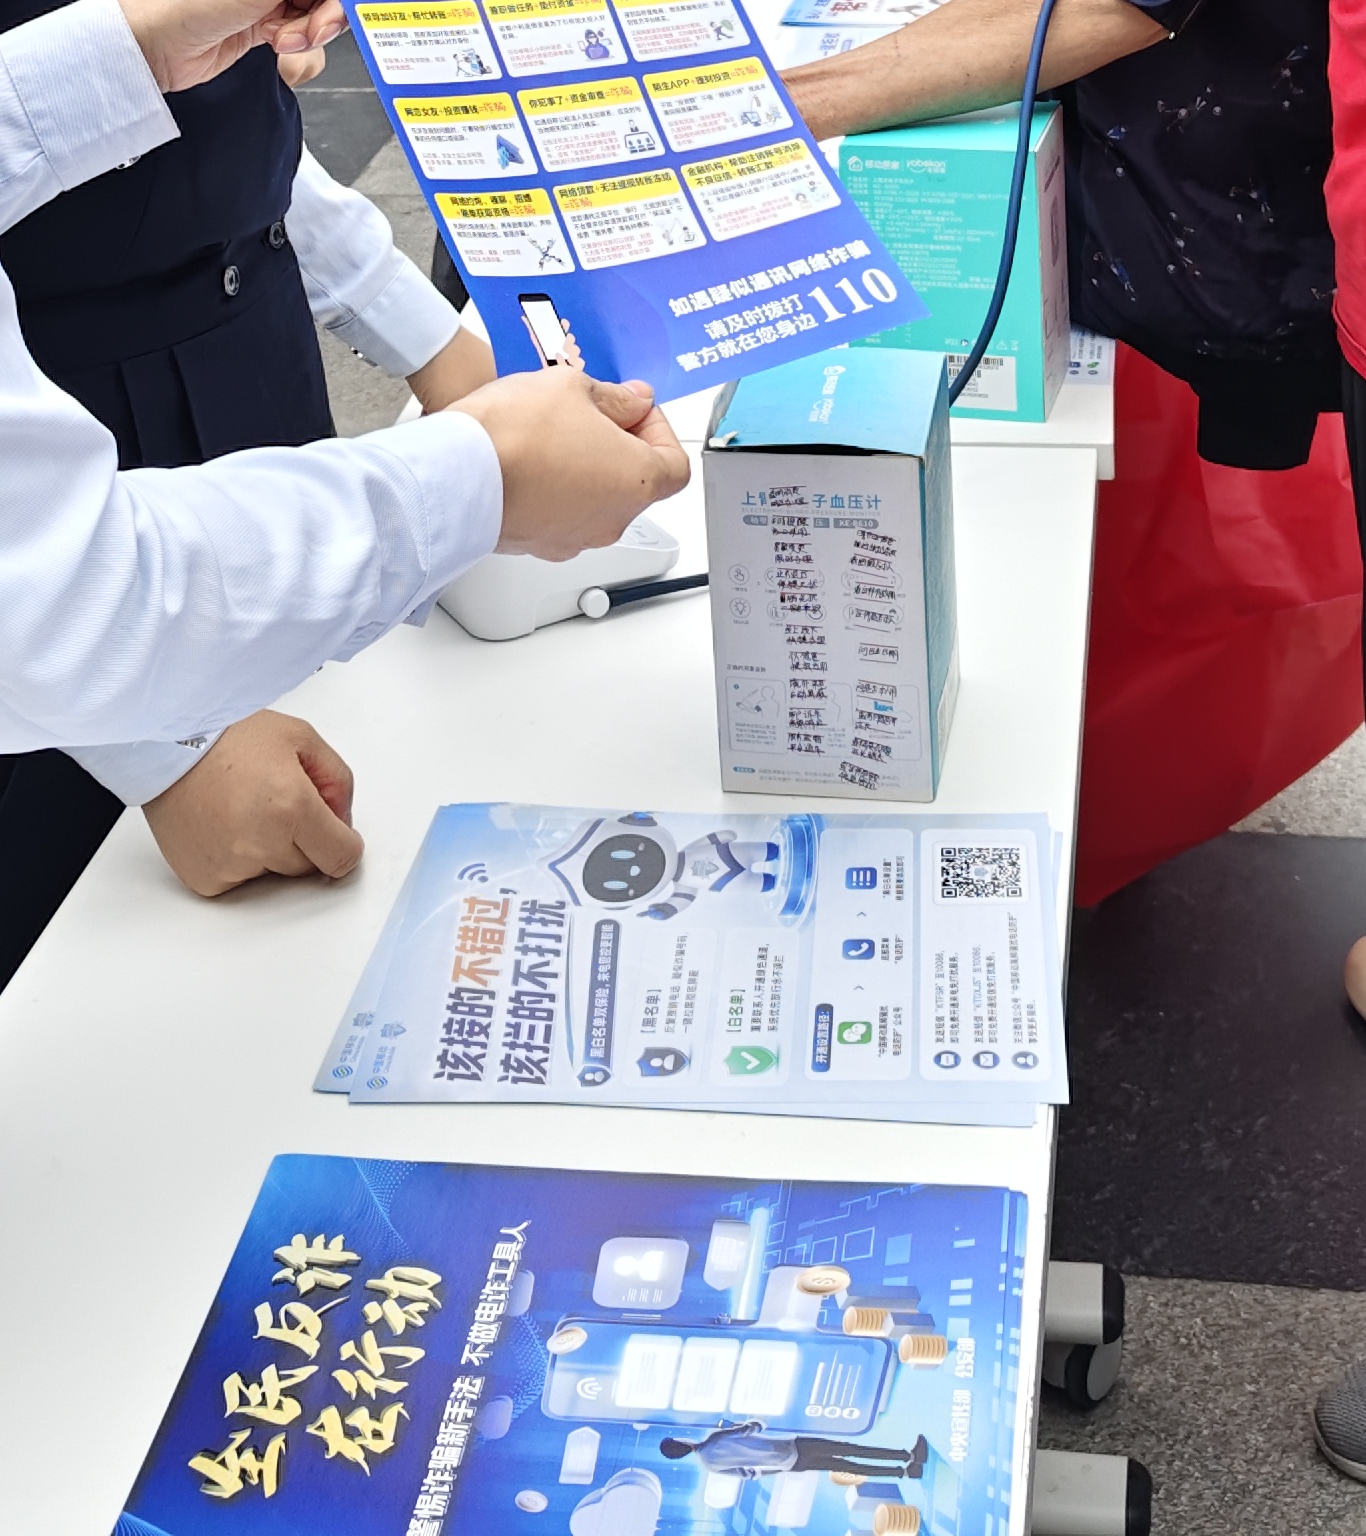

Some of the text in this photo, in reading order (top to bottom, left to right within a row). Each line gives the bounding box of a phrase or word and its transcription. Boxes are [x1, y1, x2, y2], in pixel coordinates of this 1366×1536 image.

[668, 239, 871, 318] 如遇疑似通讯网络诈骗
[676, 312, 819, 372] 警方就在您身边
[703, 267, 898, 340] 请及时拨打 110
[434, 887, 518, 1082] 该接的不错过,
[498, 899, 566, 1085] 该拦的不打扰
[725, 989, 746, 1033] 【白名单】
[187, 1233, 362, 1499] 全民反诈
[306, 1267, 442, 1477] 在行动
[406, 1220, 532, 1536] 警惕诈骗新手法 不做电诈工具人
[949, 1337, 975, 1462] 中央宣传部 公安部
